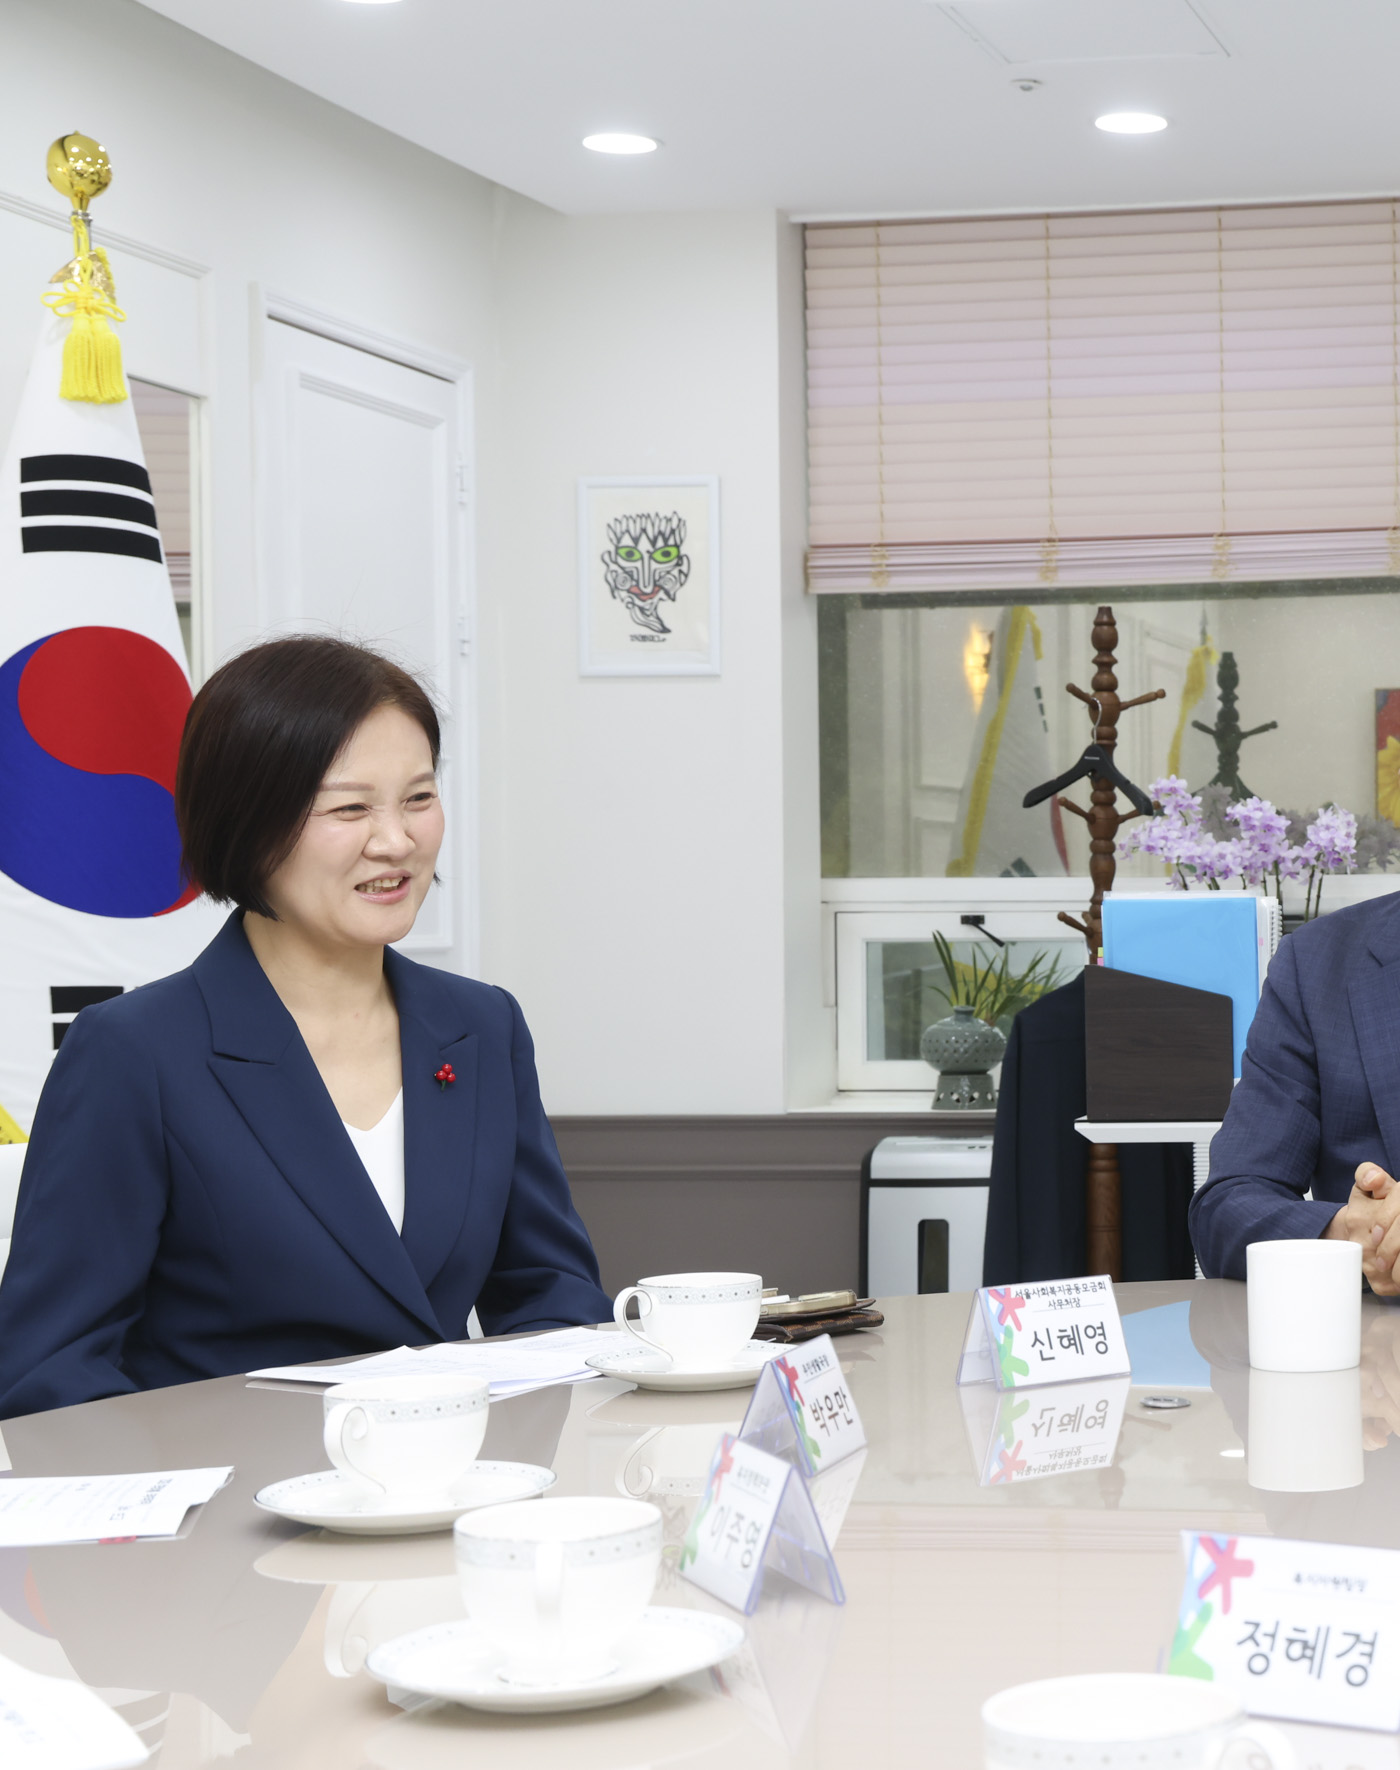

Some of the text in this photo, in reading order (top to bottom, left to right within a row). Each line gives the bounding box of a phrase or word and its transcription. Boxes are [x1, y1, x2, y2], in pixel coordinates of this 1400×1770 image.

[1014, 1280, 1107, 1300] 서울사회복지공동모금회
[1048, 1297, 1082, 1309] 사무처장
[1031, 1321, 1109, 1362] 신혜영
[810, 1386, 854, 1437] 박우만
[710, 1505, 763, 1568] 이주영
[1236, 1619, 1379, 1688] 정혜경
